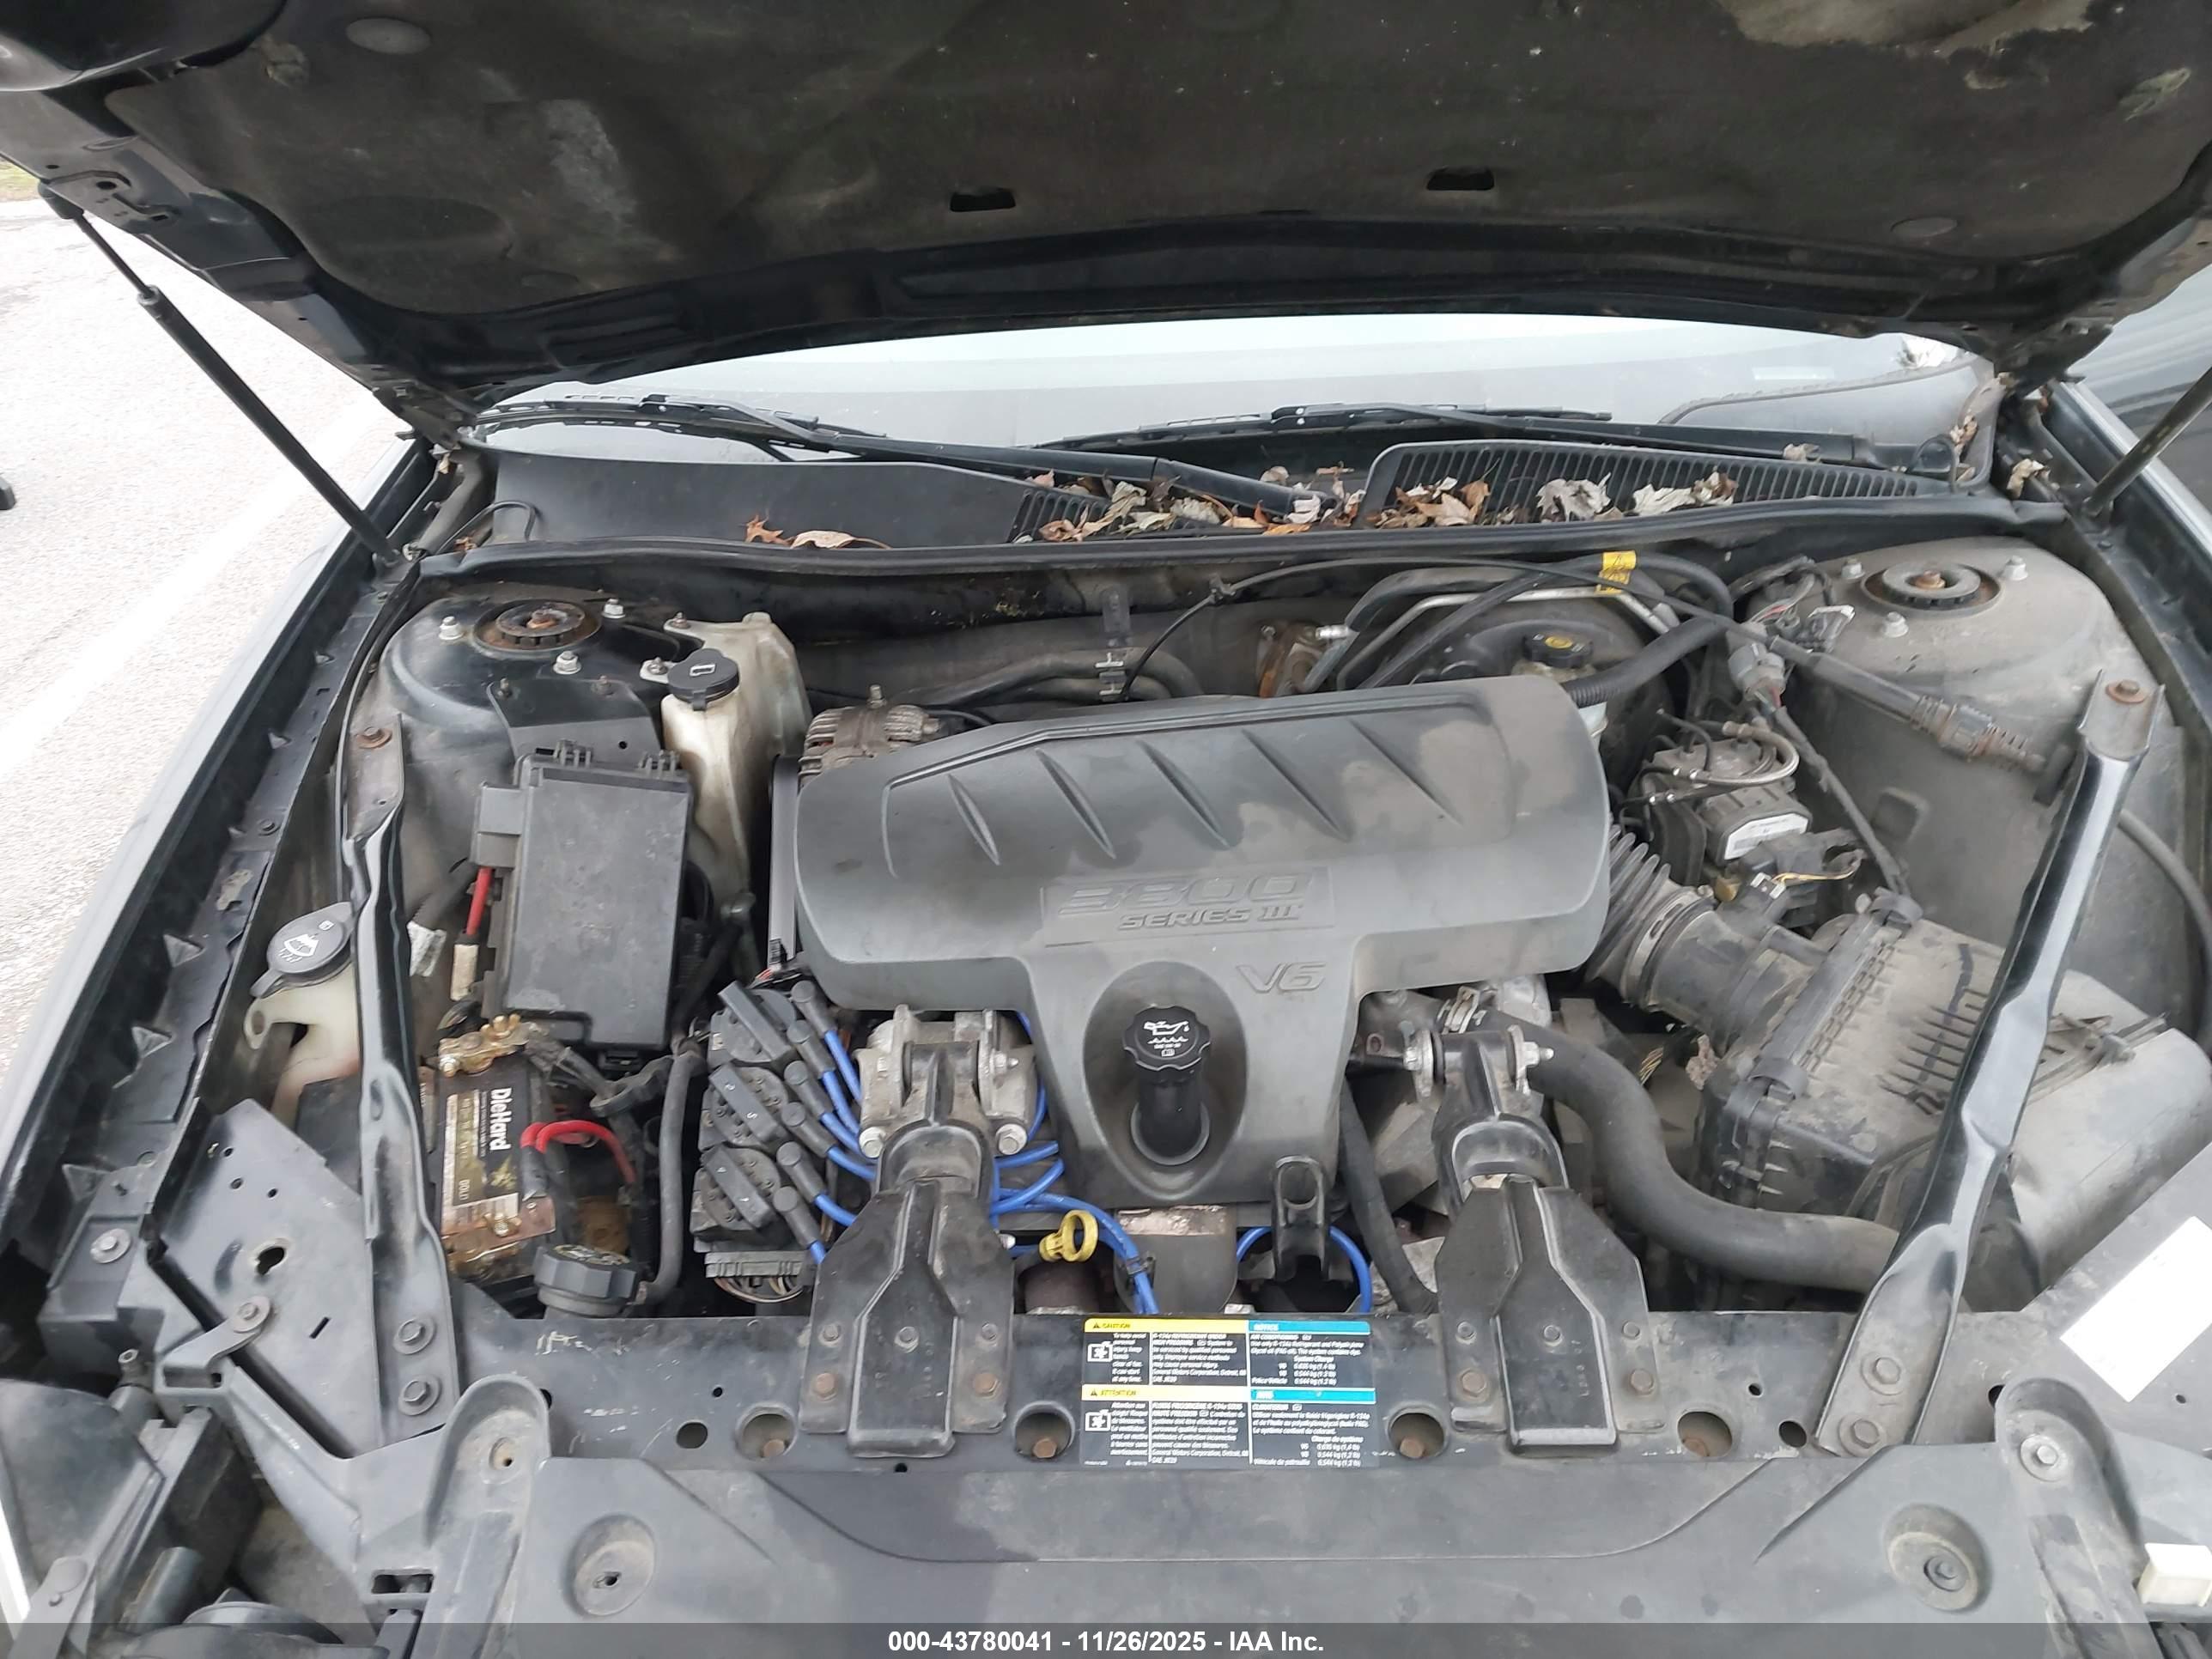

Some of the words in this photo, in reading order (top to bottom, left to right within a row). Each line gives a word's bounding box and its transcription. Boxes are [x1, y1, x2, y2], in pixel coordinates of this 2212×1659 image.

[1059, 872, 1314, 917] 3800
[1118, 908, 1251, 931] SERIES
[1256, 904, 1300, 922] III
[1236, 962, 1326, 994] V6
[489, 1086, 514, 1152] DieHard
